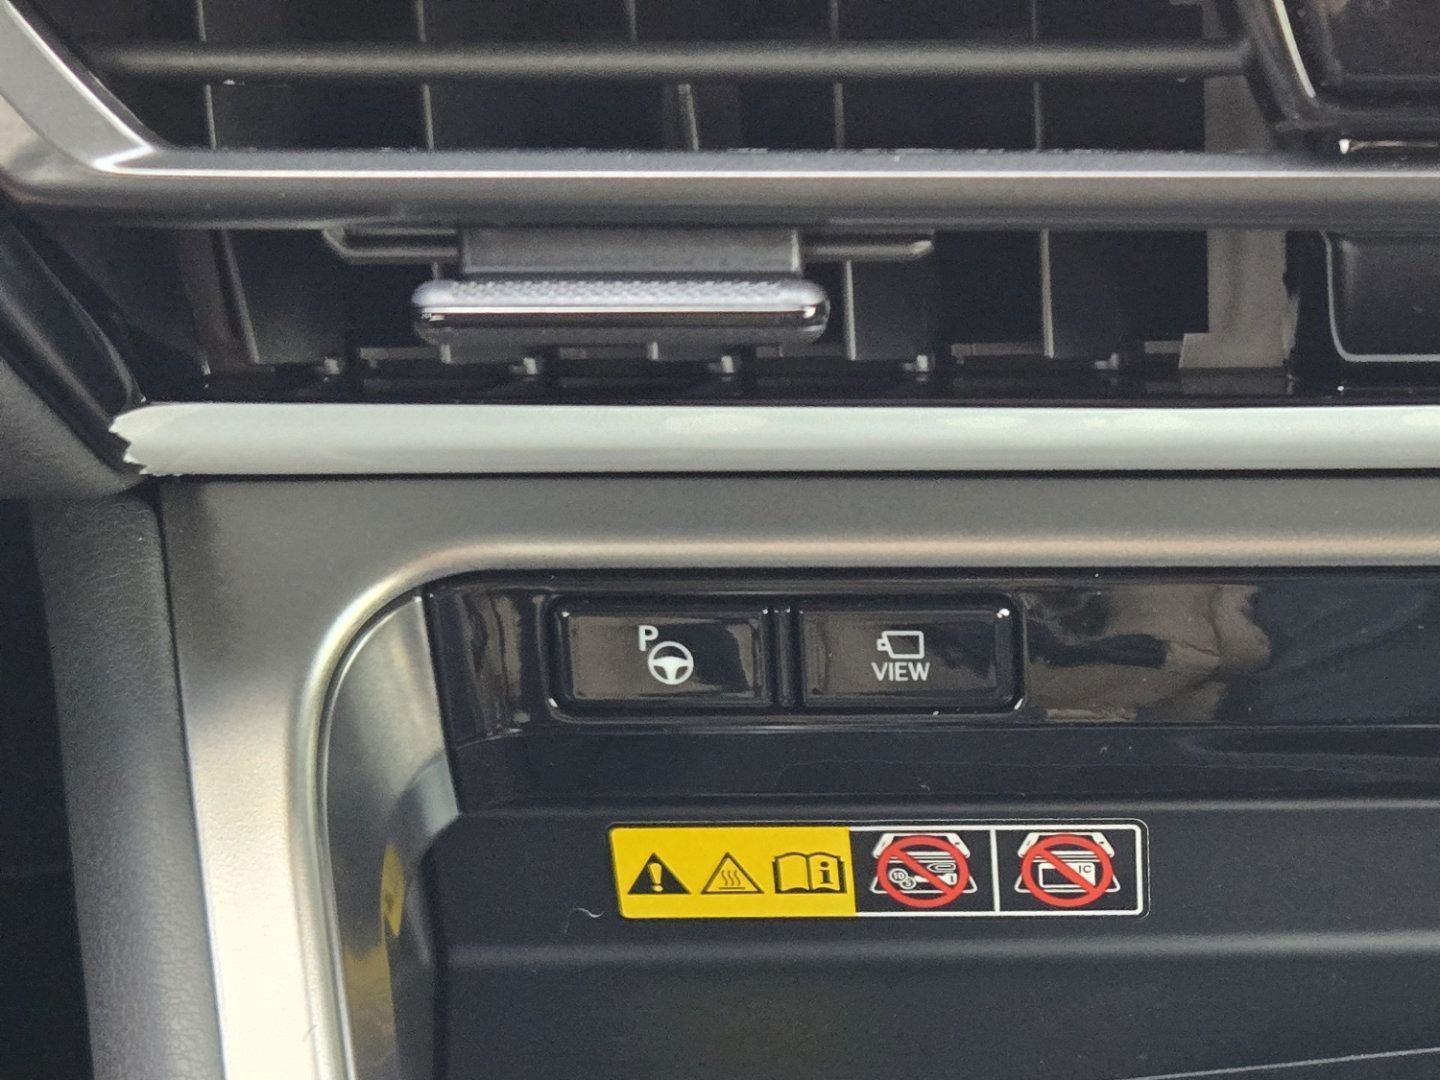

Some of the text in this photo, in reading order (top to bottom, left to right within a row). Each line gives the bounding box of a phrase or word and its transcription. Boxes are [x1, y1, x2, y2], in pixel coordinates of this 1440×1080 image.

[638, 624, 659, 652] P
[871, 661, 930, 682] VIEW
[1078, 864, 1092, 874] IC
